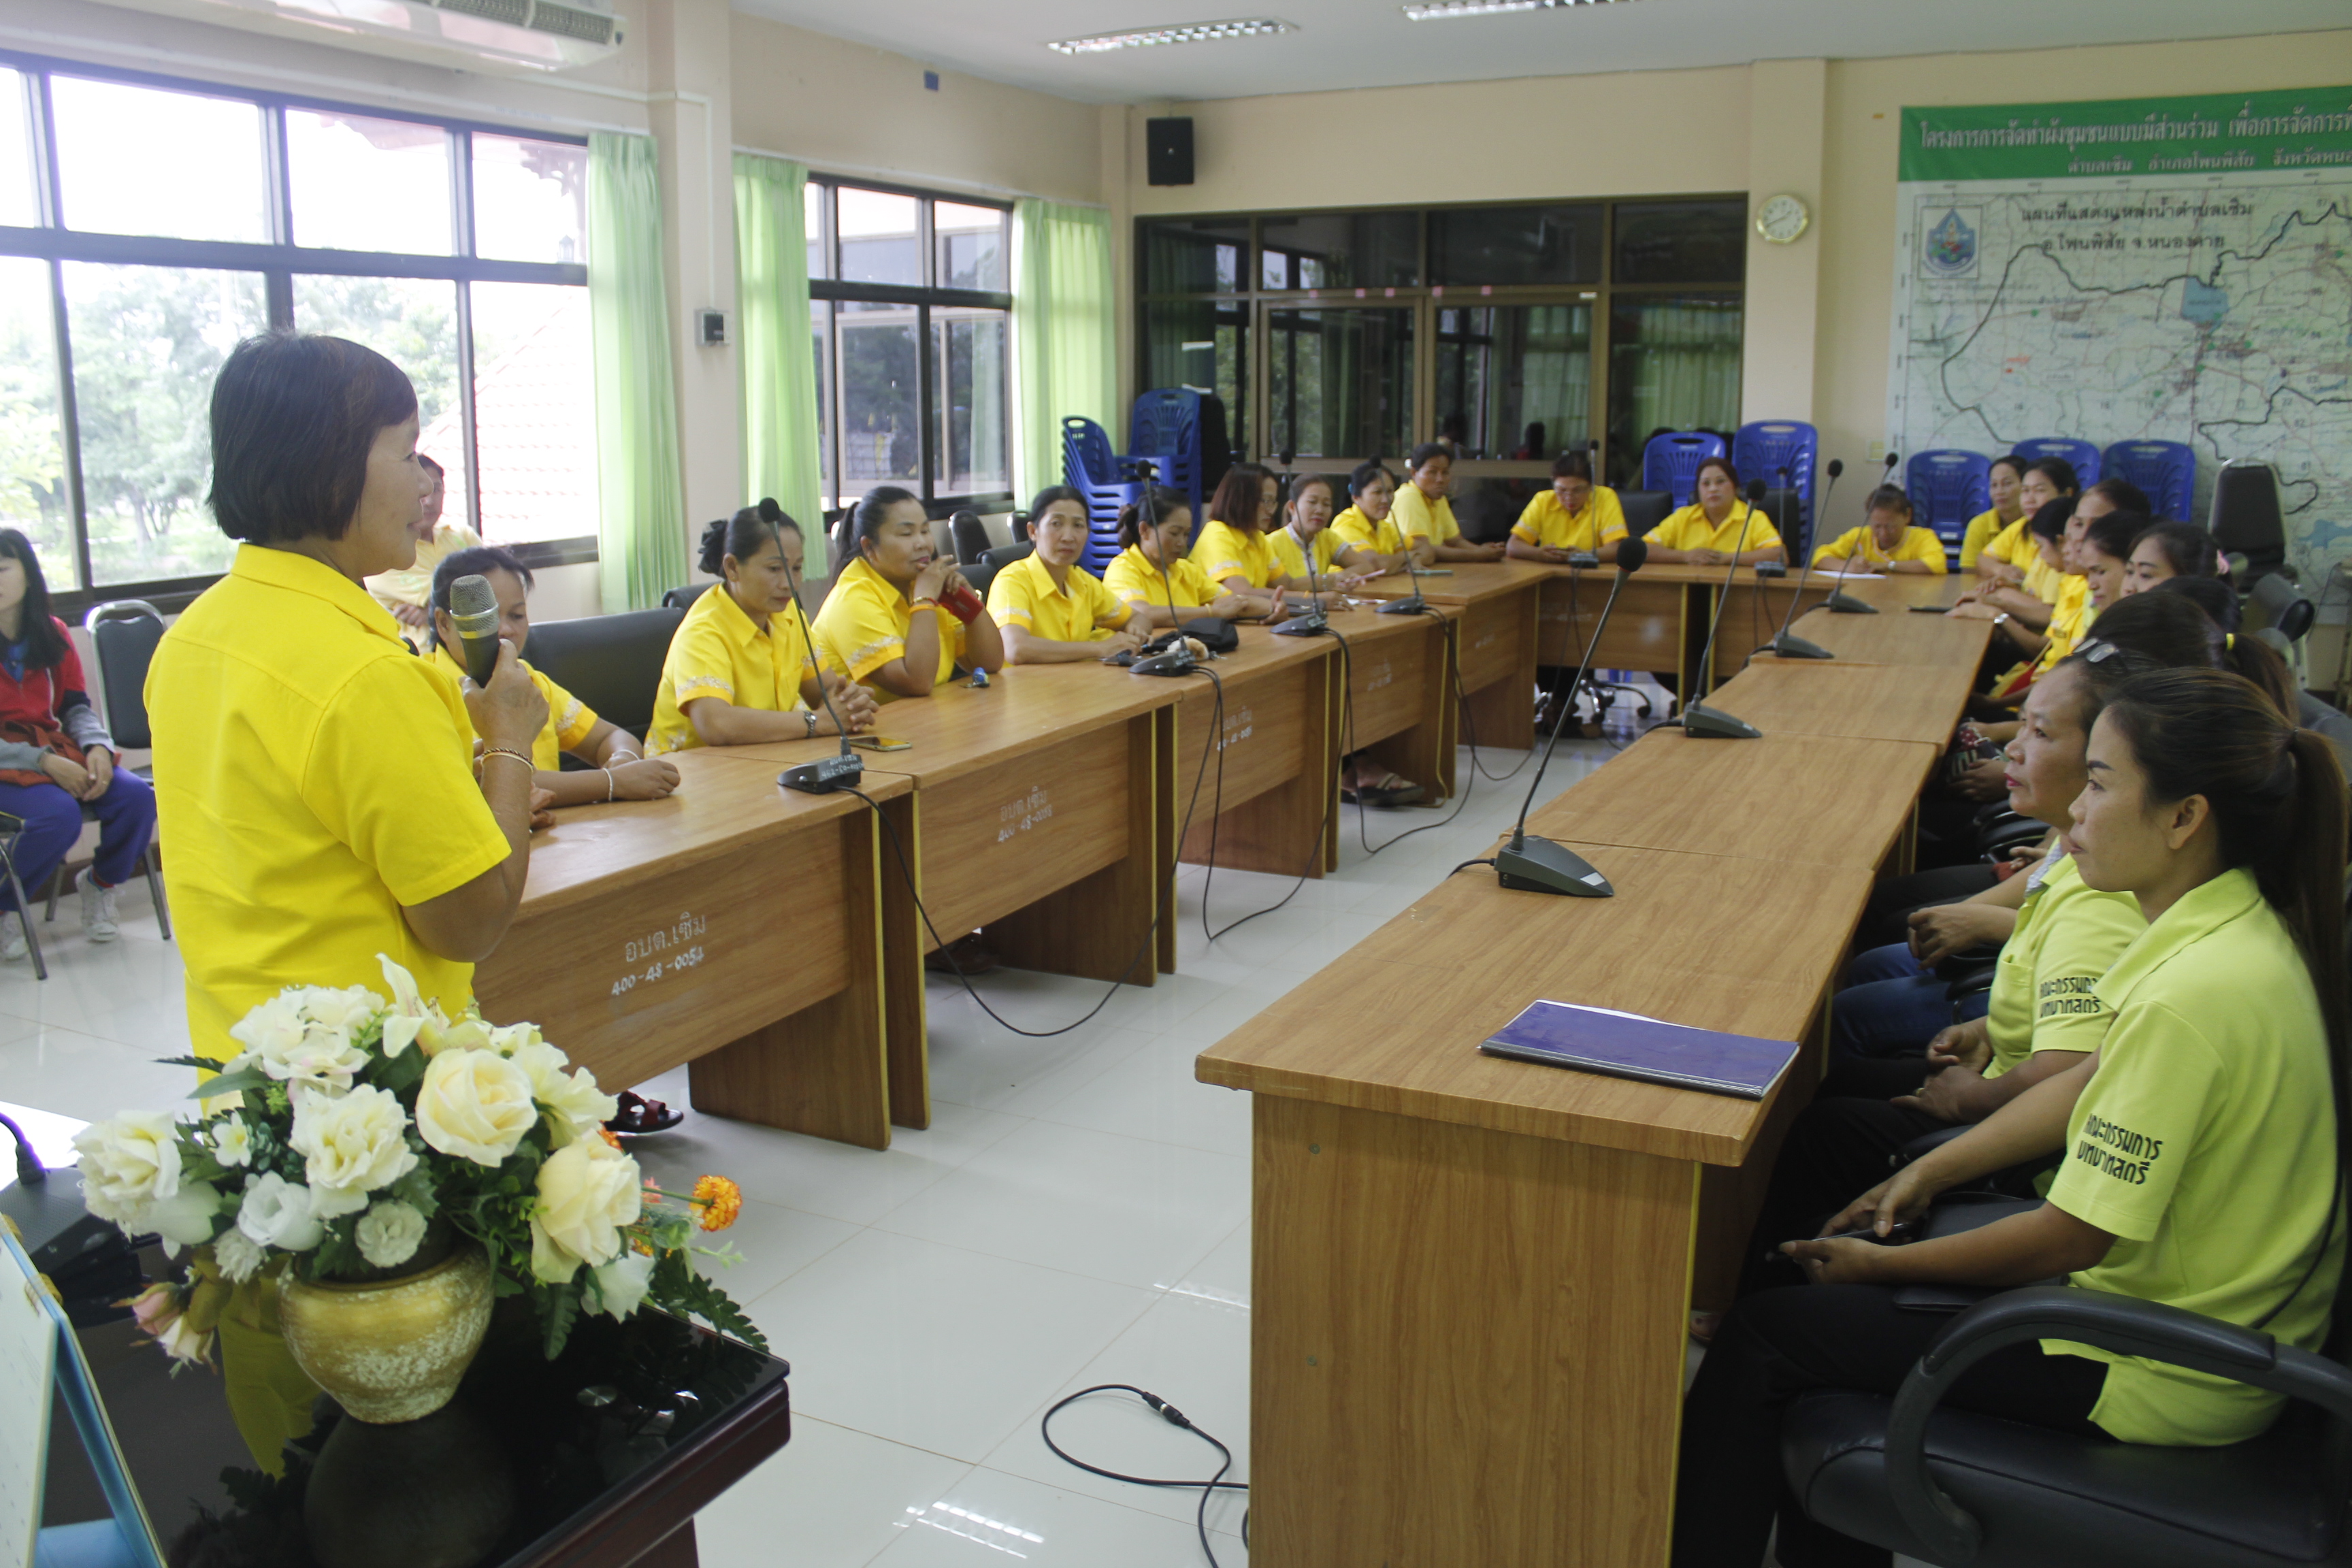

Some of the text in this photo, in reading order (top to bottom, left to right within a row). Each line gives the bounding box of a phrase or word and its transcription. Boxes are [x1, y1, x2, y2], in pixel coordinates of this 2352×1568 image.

[625, 911, 706, 962] อบต.เซิม
[2082, 1113, 2163, 1160] คณะกรรมการ
